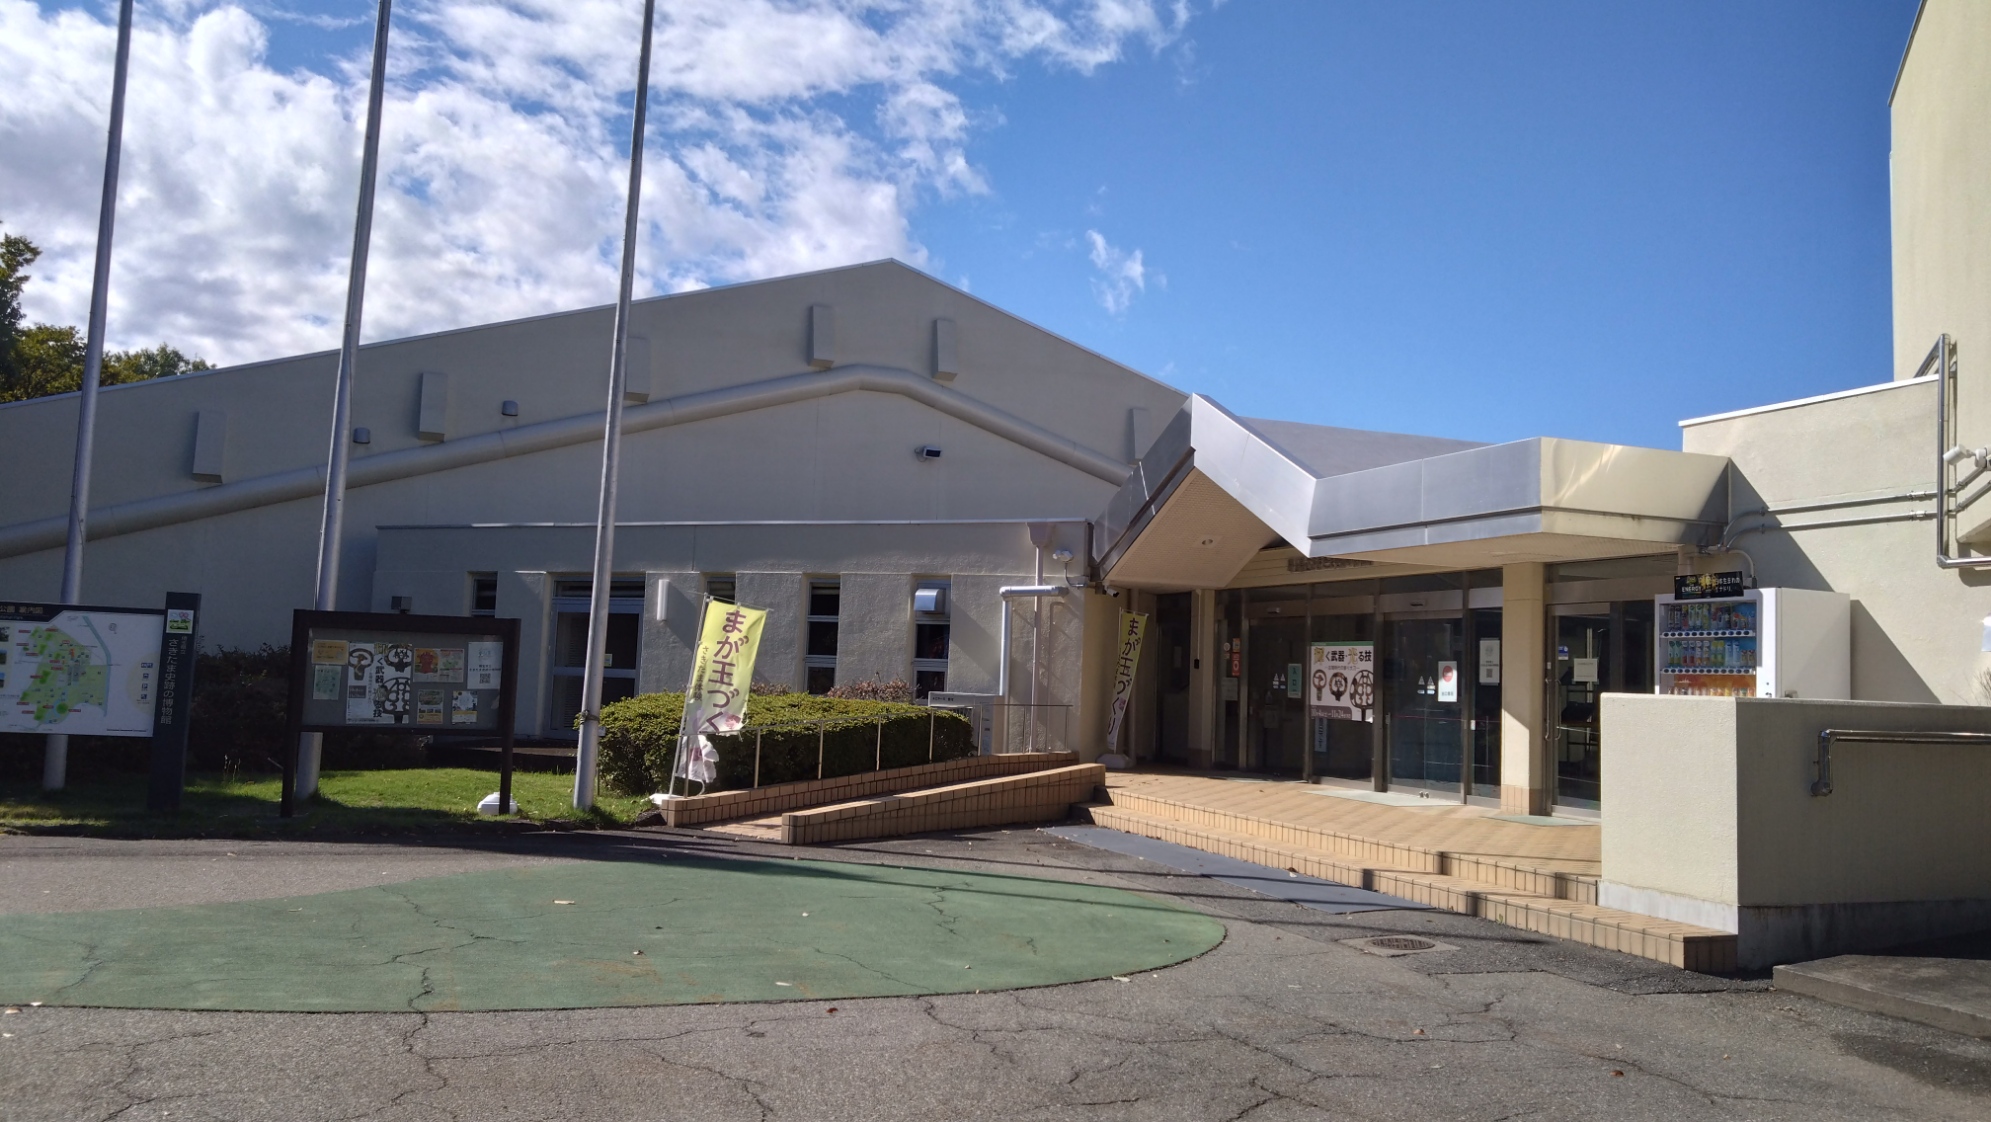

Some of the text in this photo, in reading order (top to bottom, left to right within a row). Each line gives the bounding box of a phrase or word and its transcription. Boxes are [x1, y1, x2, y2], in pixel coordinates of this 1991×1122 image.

[160, 638, 179, 725] さきたま史跡の博物館
